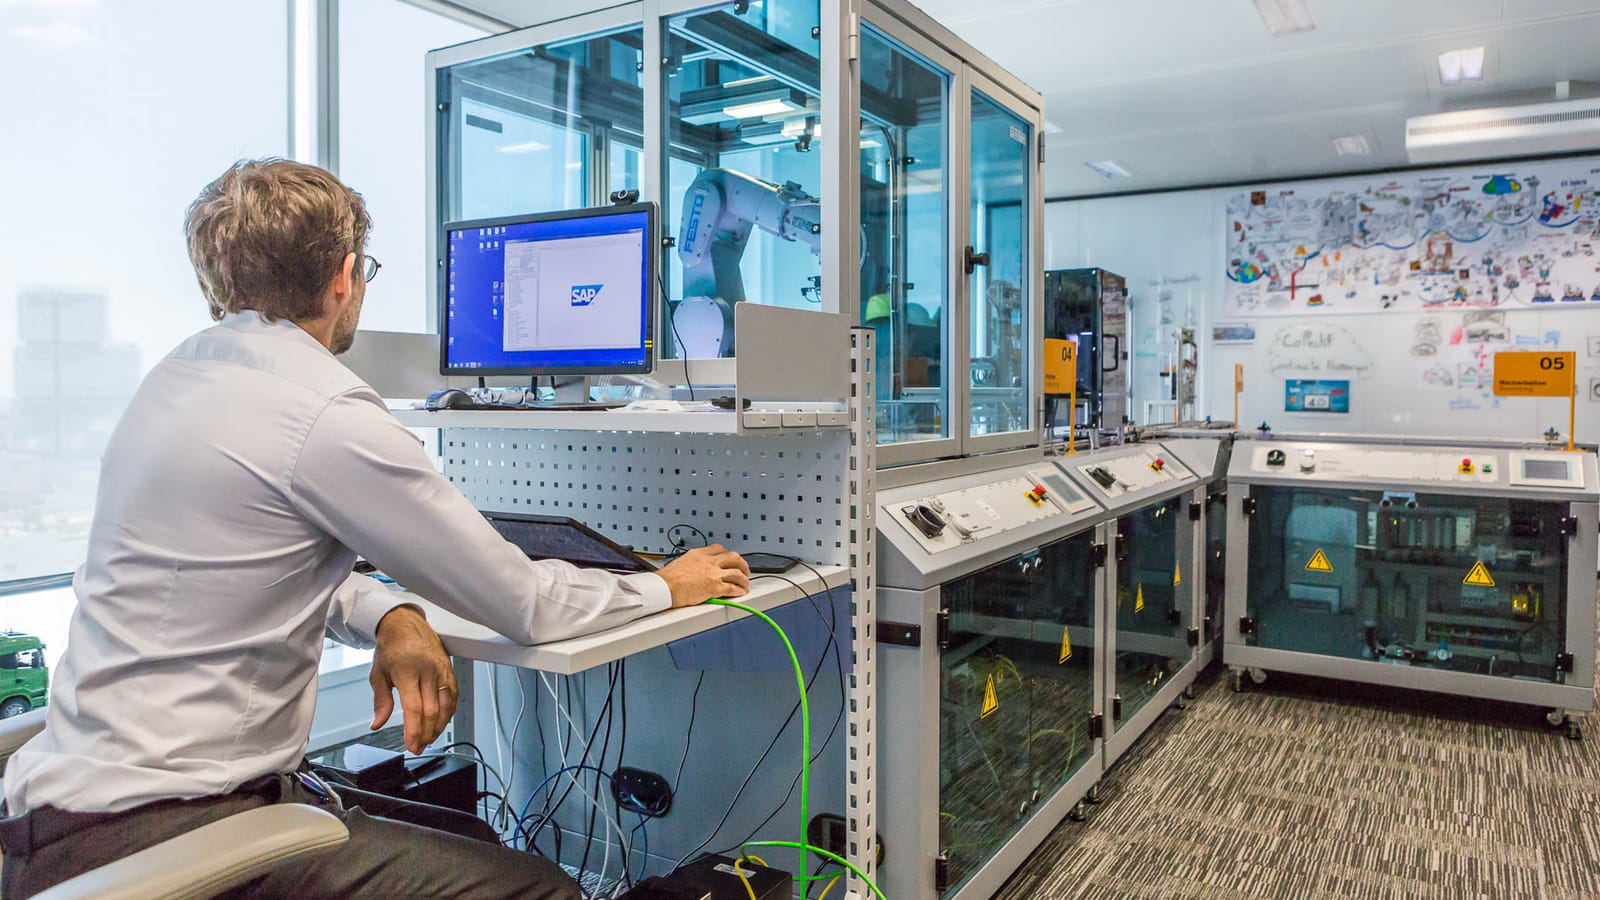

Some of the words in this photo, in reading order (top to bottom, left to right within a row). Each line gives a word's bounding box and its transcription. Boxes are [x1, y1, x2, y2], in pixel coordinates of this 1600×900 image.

[684, 194, 704, 252] FESTO
[572, 287, 596, 303] SAP
[1062, 347, 1072, 361] 04
[1540, 357, 1564, 370] 05
